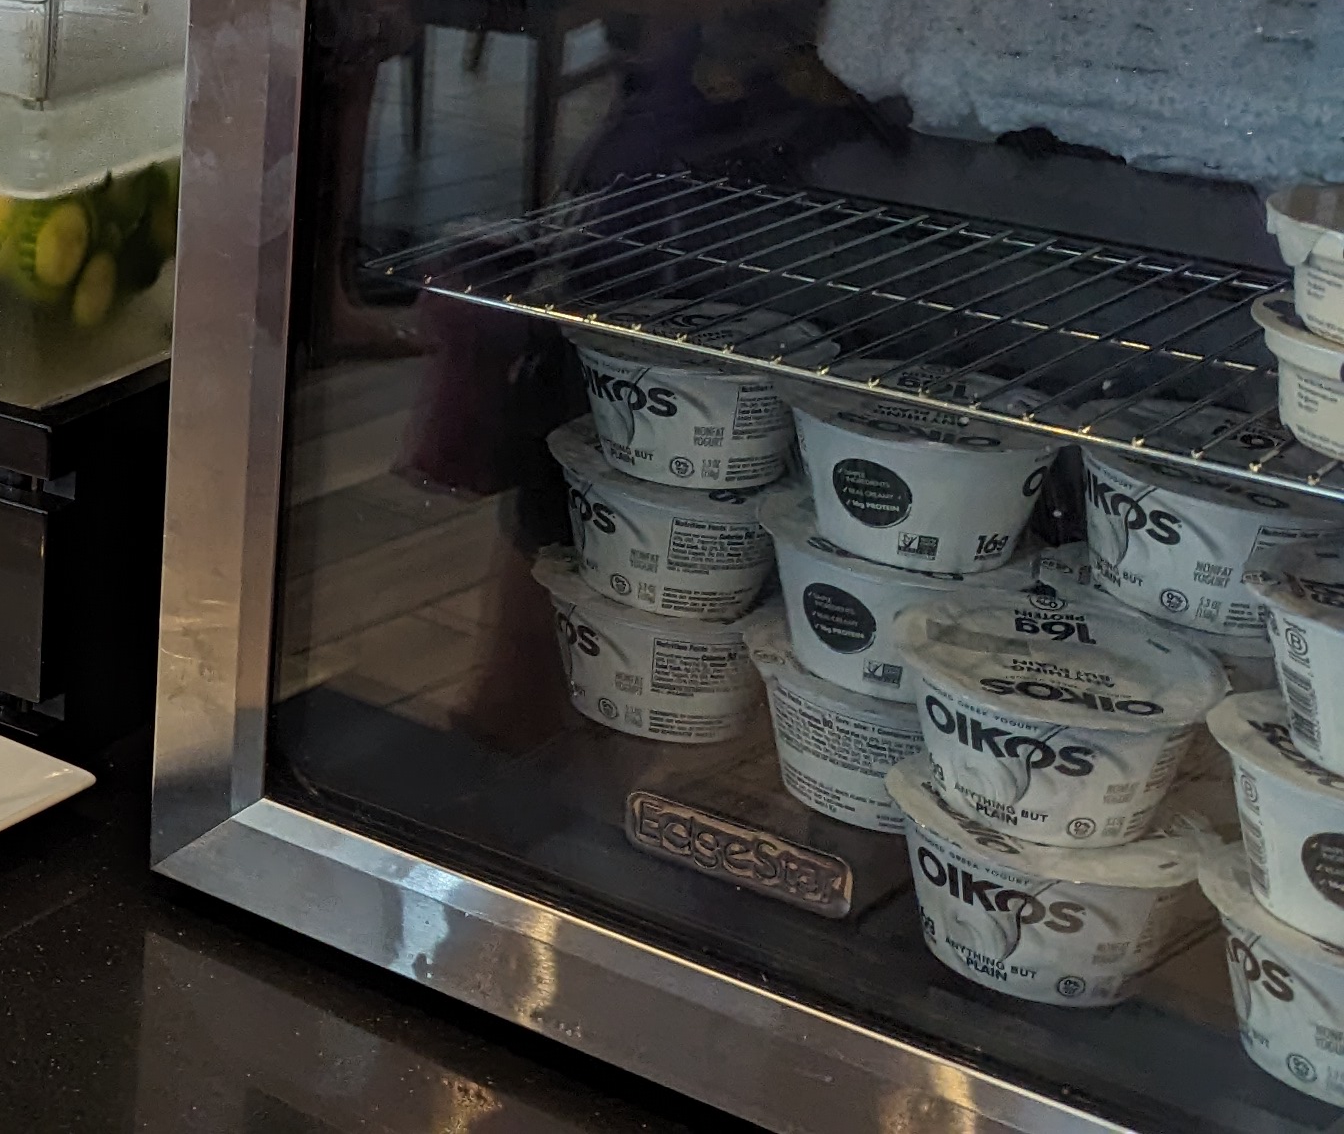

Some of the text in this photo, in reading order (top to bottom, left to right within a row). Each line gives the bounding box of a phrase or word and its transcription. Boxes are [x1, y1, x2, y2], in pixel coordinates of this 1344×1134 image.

[583, 365, 678, 417] IKOS
[634, 450, 654, 462] BUT
[866, 502, 900, 512] PROTEIN
[1086, 469, 1181, 546] IKOS
[975, 534, 1009, 556] 16g
[1122, 572, 1144, 587] BUT
[1196, 561, 1233, 577] NONFAT
[1014, 617, 1096, 645] 16g
[979, 678, 1164, 716] OIKOS
[925, 694, 1096, 776] OIKOS
[994, 716, 1039, 731] YOGURT
[955, 782, 1049, 822] ANYTHING BUT
[976, 803, 1018, 826] PLAIN
[638, 800, 844, 906] EdgeStar
[917, 846, 1086, 934] OIKOS
[945, 937, 1037, 979] ANYTHING BUT
[966, 957, 1007, 981] PLAIN
